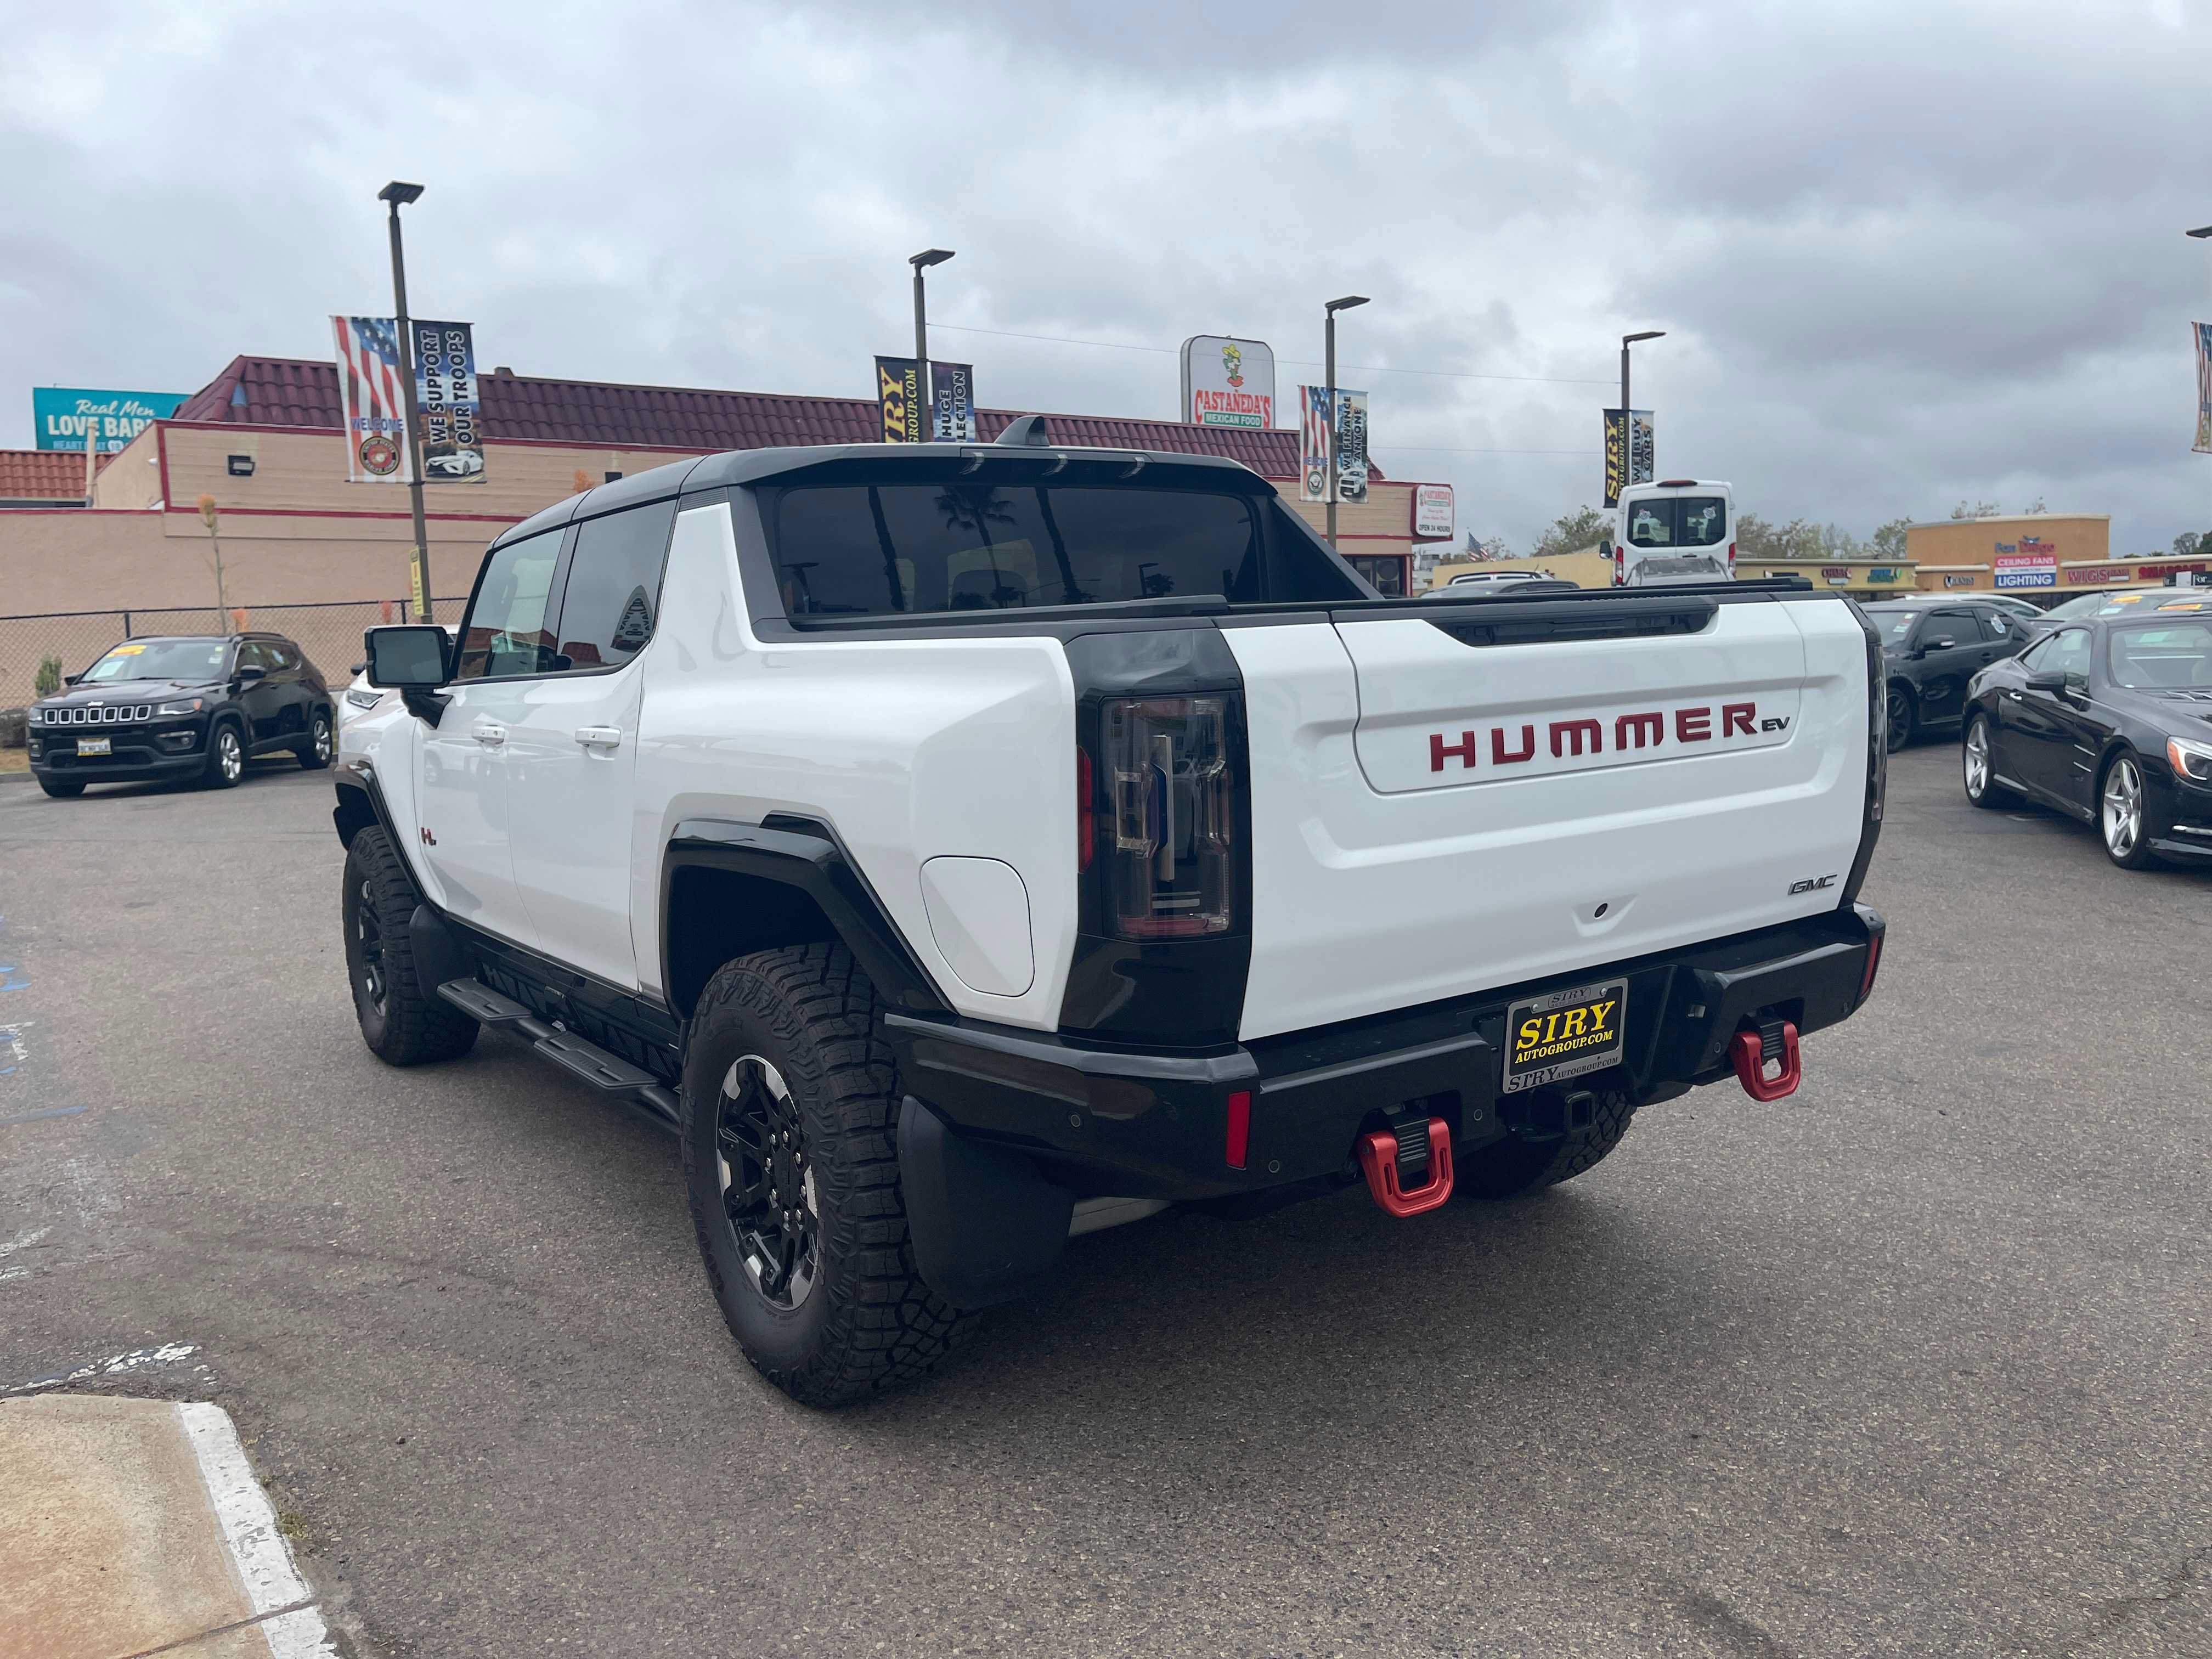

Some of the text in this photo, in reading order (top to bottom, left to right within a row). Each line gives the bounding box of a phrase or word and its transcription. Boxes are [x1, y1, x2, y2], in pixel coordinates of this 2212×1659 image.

[420, 330, 448, 444] WE SUPPORT
[445, 331, 473, 445] OUR TROOPS
[47, 415, 100, 437] LOVE
[76, 399, 155, 416] Real Men
[351, 417, 404, 431] WELCOME
[939, 390, 952, 437] HUGE
[952, 371, 967, 443] LECTION
[1206, 413, 1261, 426] MEXICAN FOOD
[1343, 396, 1351, 470] WE FINANCE
[1353, 408, 1362, 462] ANYONE
[1633, 418, 1641, 483] WE BUY
[1643, 430, 1651, 472] CARS
[1606, 416, 1618, 500] SIRY
[1997, 556, 2054, 566] CEILING FANS
[1998, 574, 2052, 586] LIGHTING
[2067, 569, 2107, 583] WIGS
[1430, 702, 1790, 772] HUMMER EV
[1788, 873, 1838, 896] GMC
[1551, 988, 1588, 1003] SIRY
[1516, 1001, 1616, 1051] SIRY
[1515, 1029, 1614, 1064] AUTOGROUP.COM
[1508, 1057, 1618, 1092] SIRY AUTOGROUP.COM
